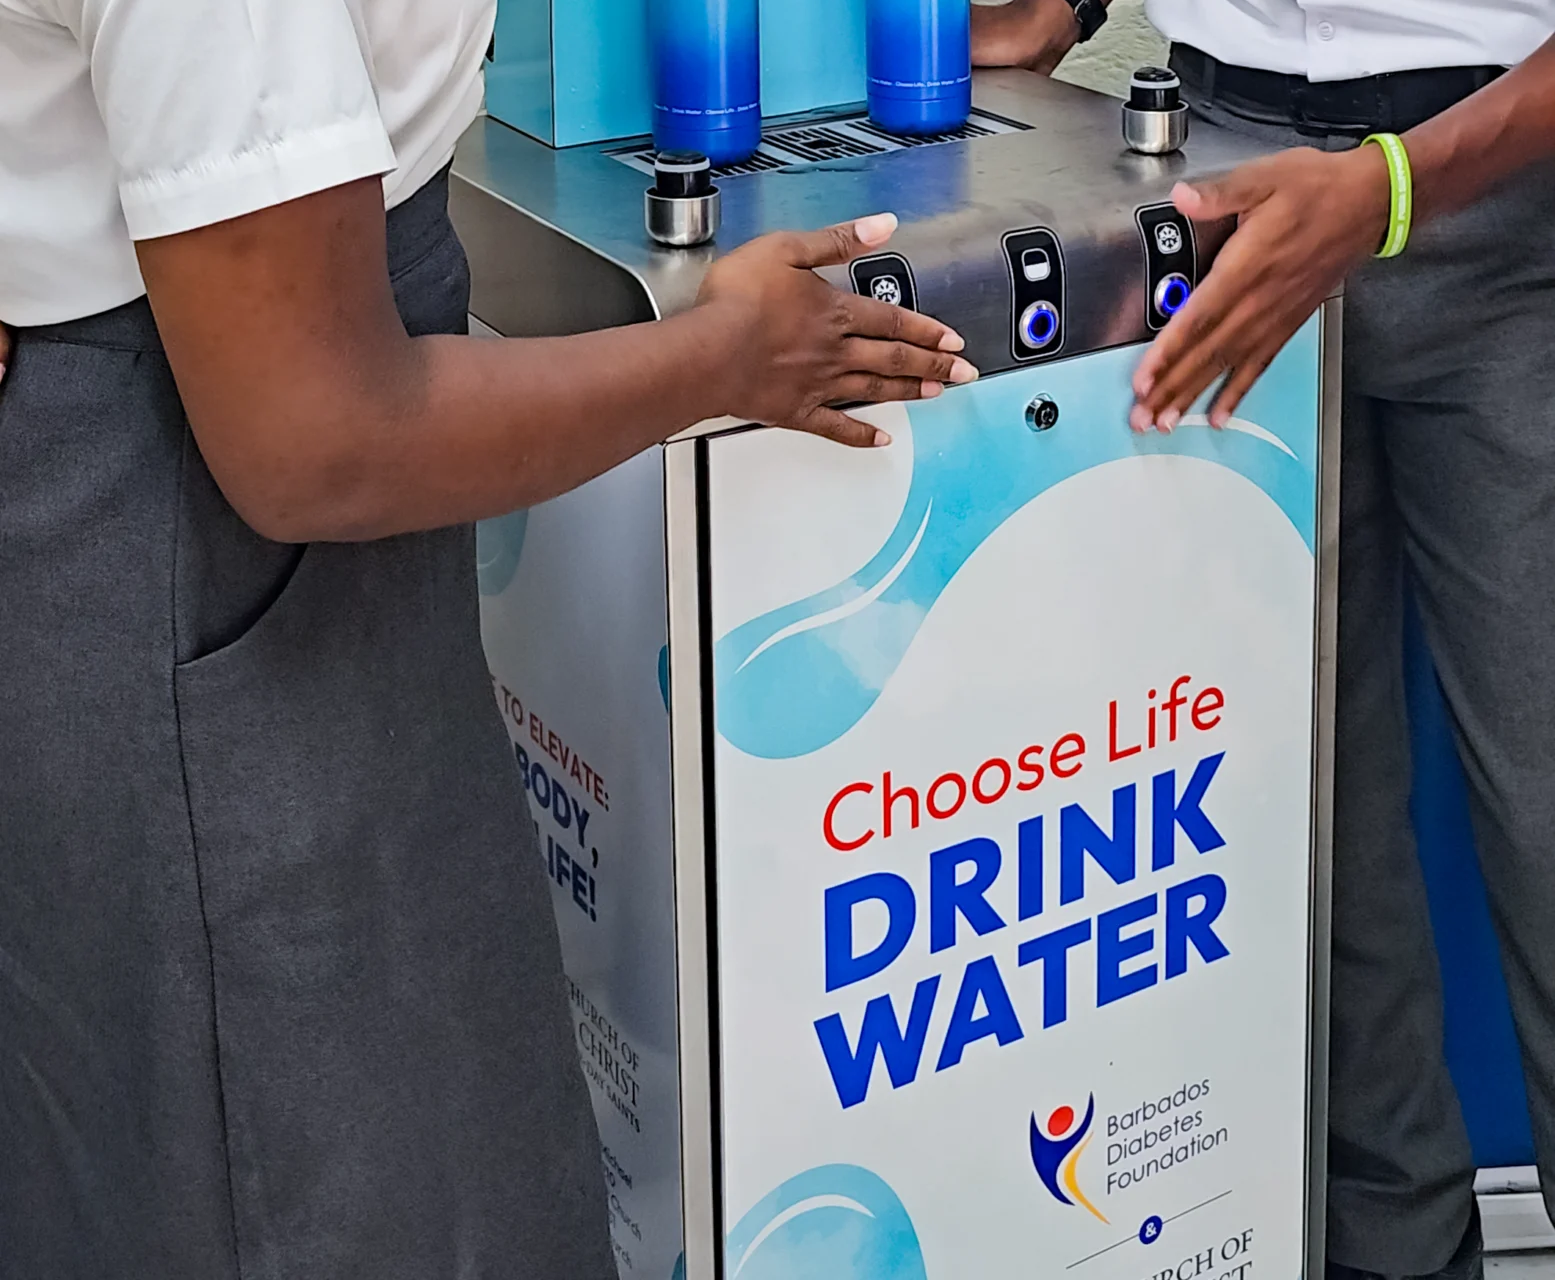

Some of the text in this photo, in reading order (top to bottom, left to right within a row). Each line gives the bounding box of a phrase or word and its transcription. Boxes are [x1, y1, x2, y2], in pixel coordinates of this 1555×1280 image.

[501, 684, 610, 813] TO ELEVATE:
[822, 675, 1226, 852] Choose Life
[540, 826, 598, 923] IFE!
[823, 750, 1227, 993] DRINK
[812, 873, 1231, 1110] WATER
[579, 1021, 641, 1107] CHRIST
[620, 1041, 640, 1072] OF
[605, 1083, 641, 1134] SAINTS
[1107, 1078, 1211, 1138] Barbados
[1107, 1110, 1203, 1167] Diabetes
[1107, 1127, 1228, 1196] Foundation
[1144, 1221, 1158, 1239] &
[1154, 1247, 1214, 1280] RCH
[1220, 1228, 1254, 1261] OF
